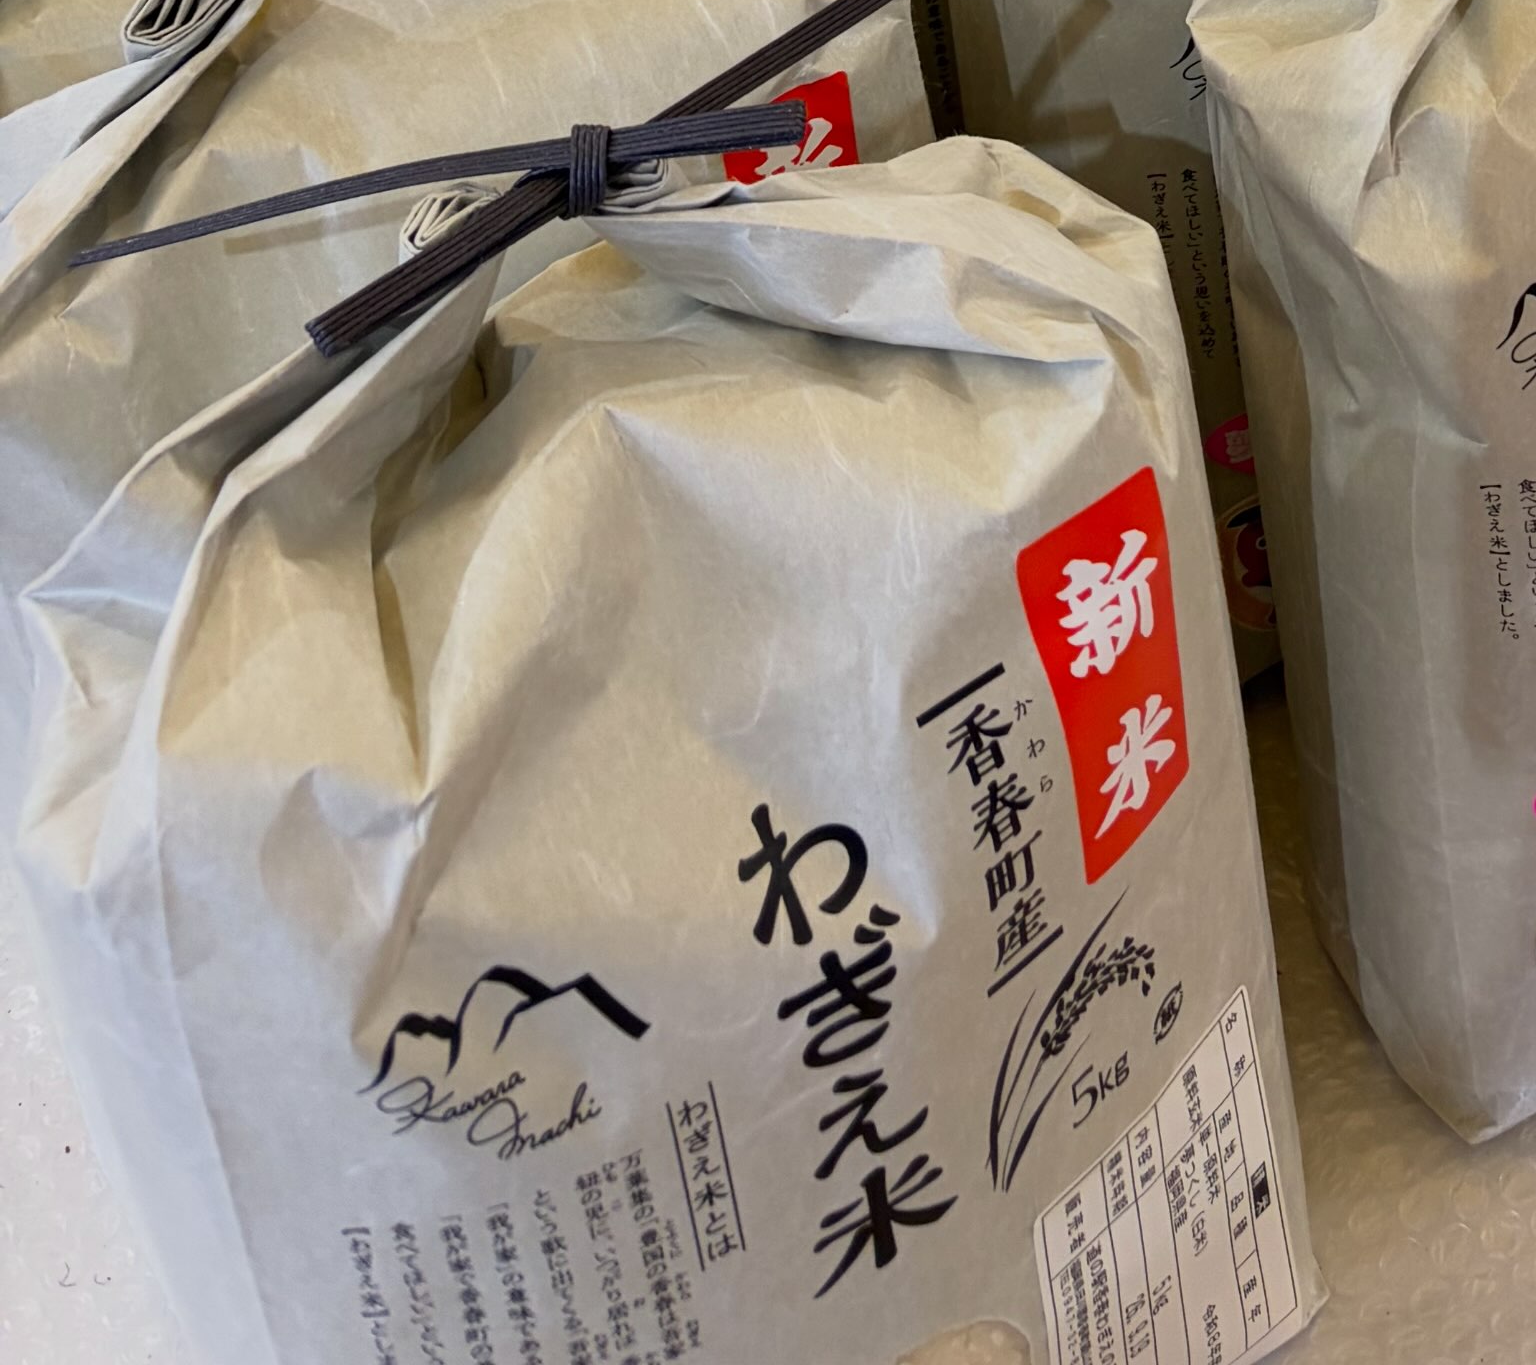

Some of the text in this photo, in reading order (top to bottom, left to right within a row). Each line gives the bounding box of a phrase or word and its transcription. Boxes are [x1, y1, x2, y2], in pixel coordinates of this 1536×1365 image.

[1479, 485, 1520, 640] 【わぎえ米】としました。
[1013, 695, 1056, 794] かわら
[1057, 529, 1178, 841] 新米
[945, 700, 1050, 967] 香春町産
[737, 802, 957, 1299] わぎえ米
[1071, 1050, 1130, 1129] 5kg
[678, 1099, 738, 1261] わぎえ米とは
